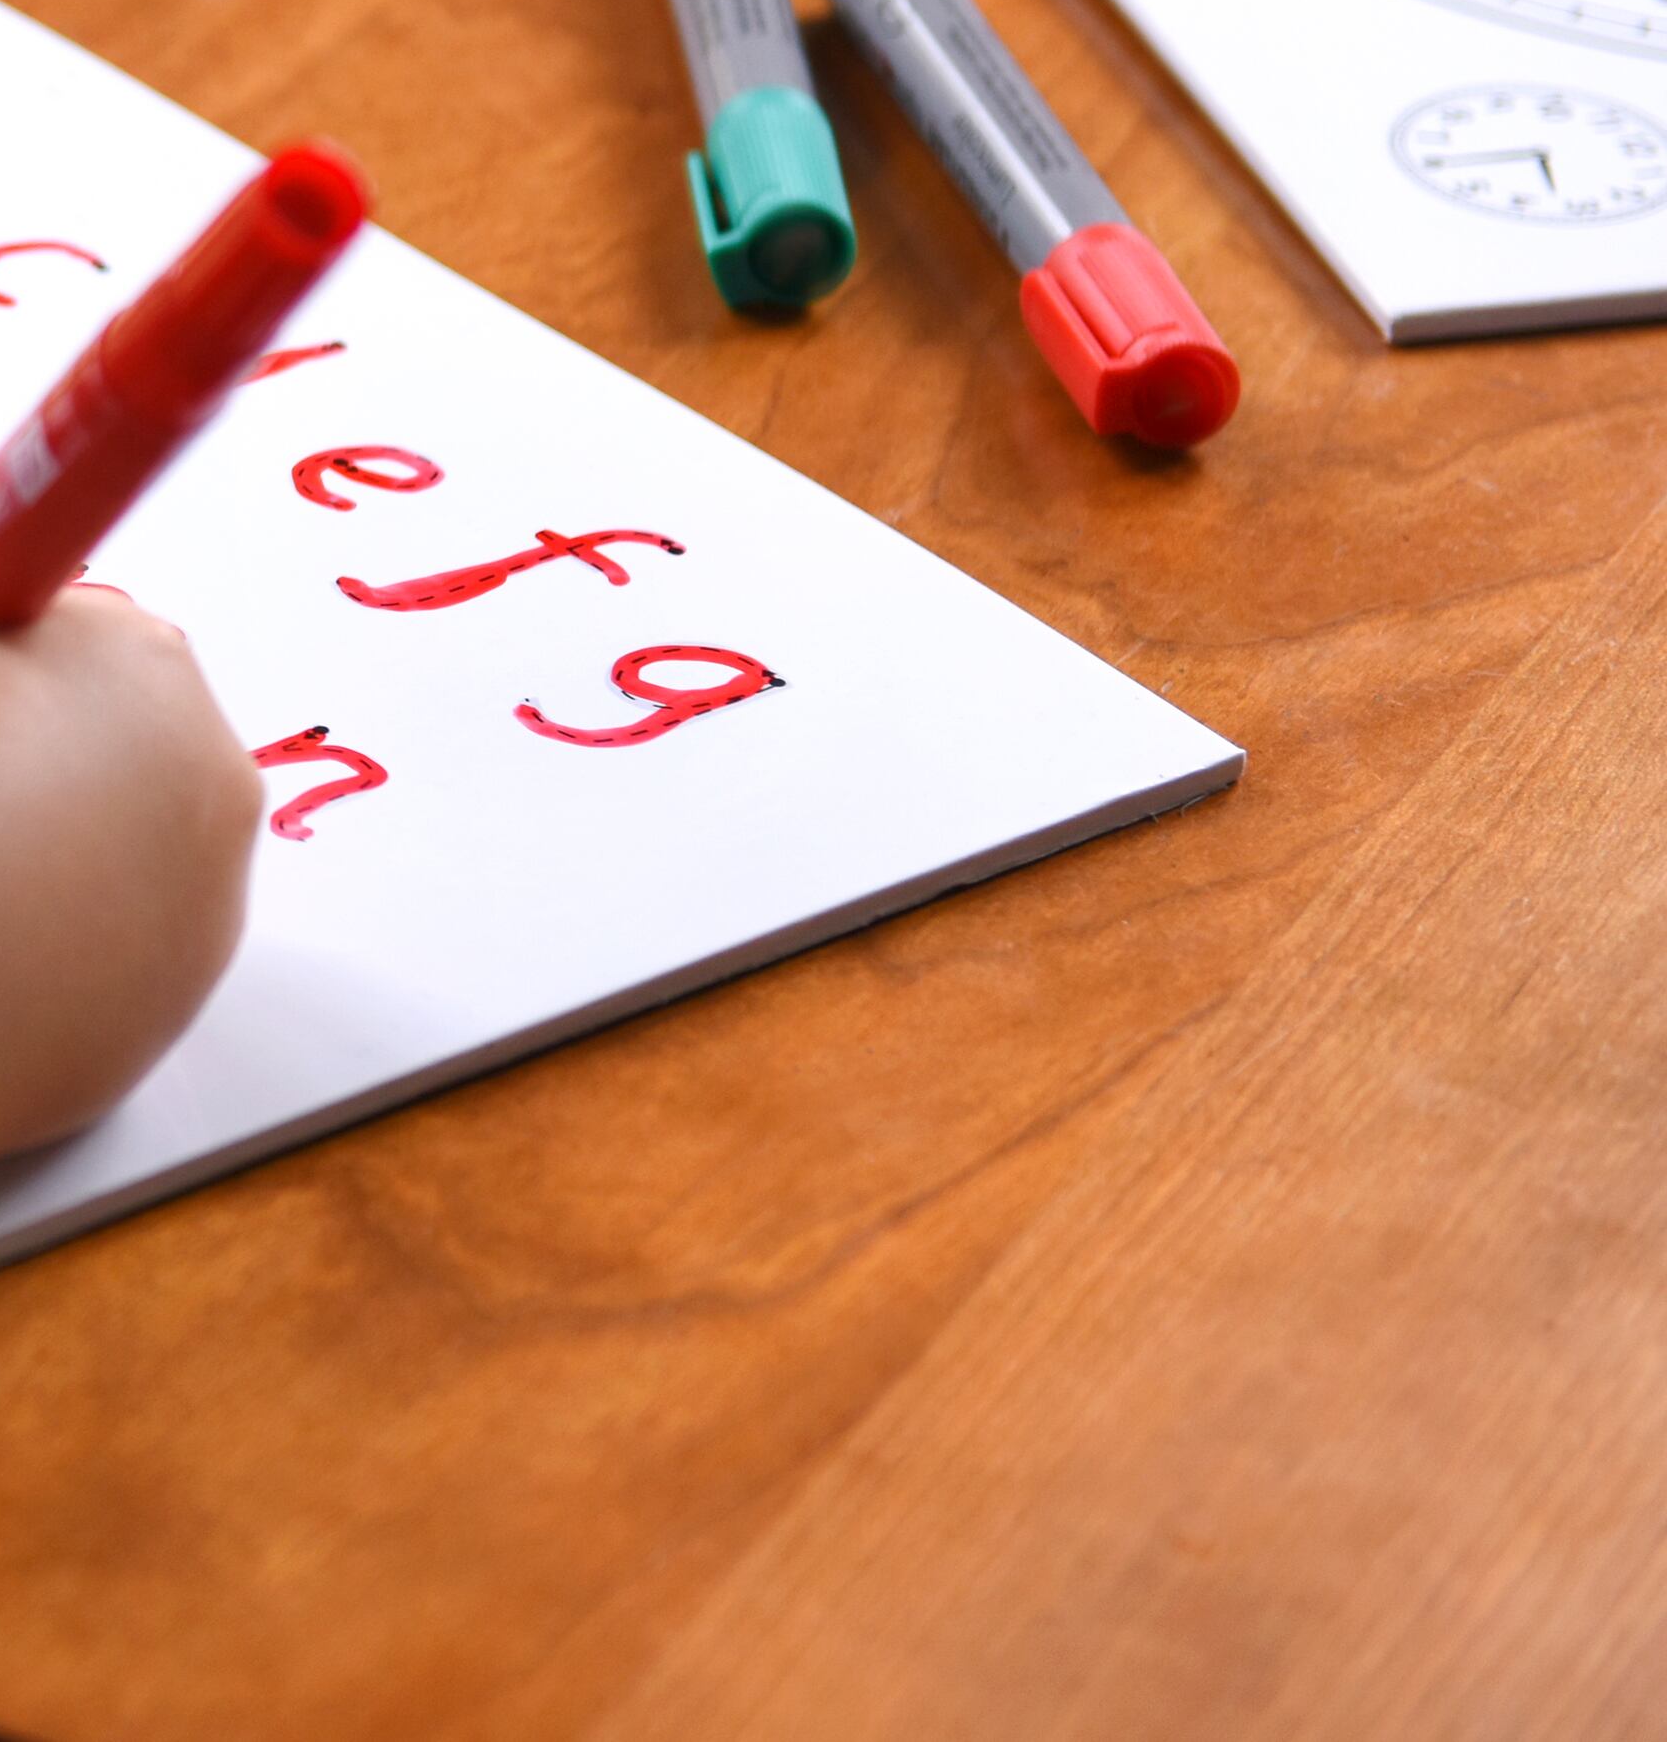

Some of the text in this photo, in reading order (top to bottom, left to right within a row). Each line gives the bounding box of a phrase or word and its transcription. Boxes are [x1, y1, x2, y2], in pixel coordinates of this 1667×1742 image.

[291, 445, 445, 512] e
[336, 529, 686, 612] f
[513, 645, 786, 748] g
[255, 725, 389, 842] n
